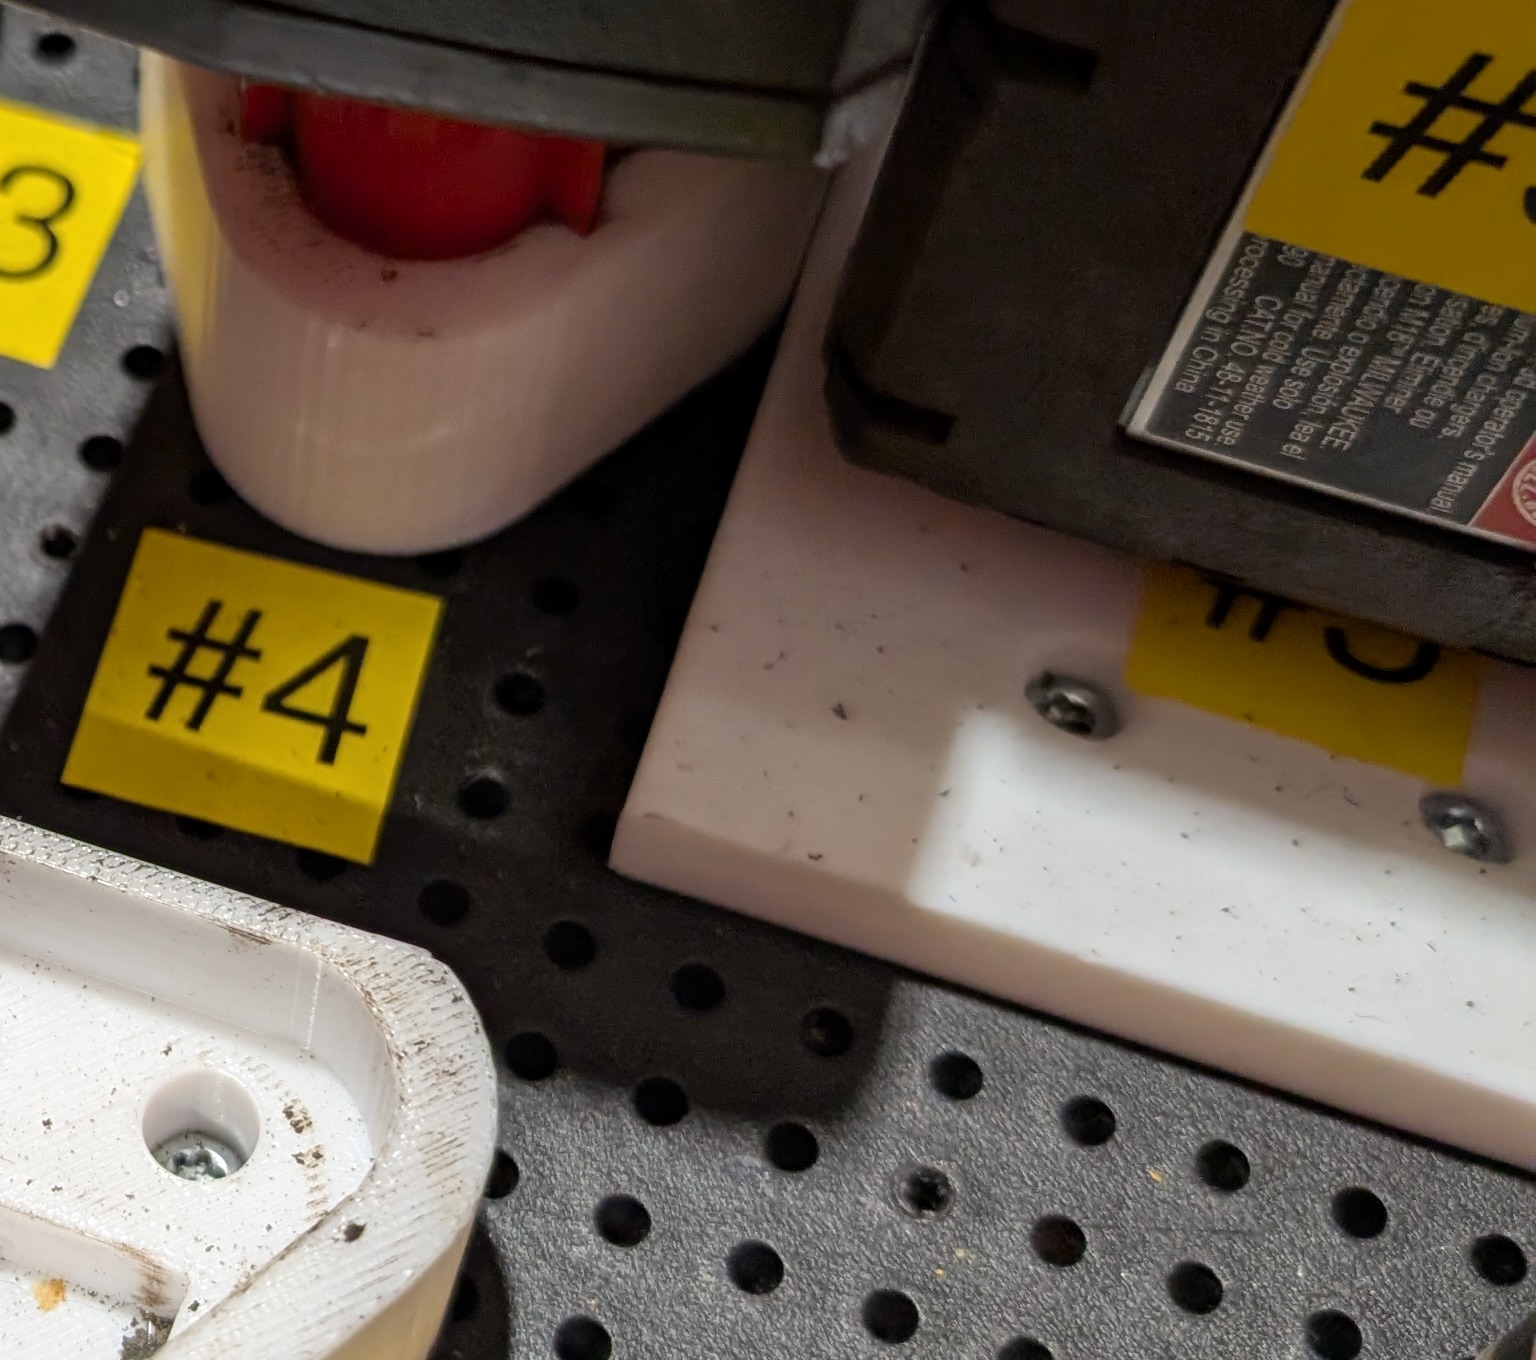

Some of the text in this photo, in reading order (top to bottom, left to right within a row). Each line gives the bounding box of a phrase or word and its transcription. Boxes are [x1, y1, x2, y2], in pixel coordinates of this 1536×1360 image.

[1200, 330, 1220, 344] in
[1174, 346, 1220, 394] China
[1290, 346, 1331, 377] Use
[1184, 368, 1247, 442] 48-11-1815
[1272, 377, 1304, 410] solo
[1408, 408, 1437, 429] ou
[1463, 387, 1528, 461] operator's
[147, 598, 372, 765] #4
